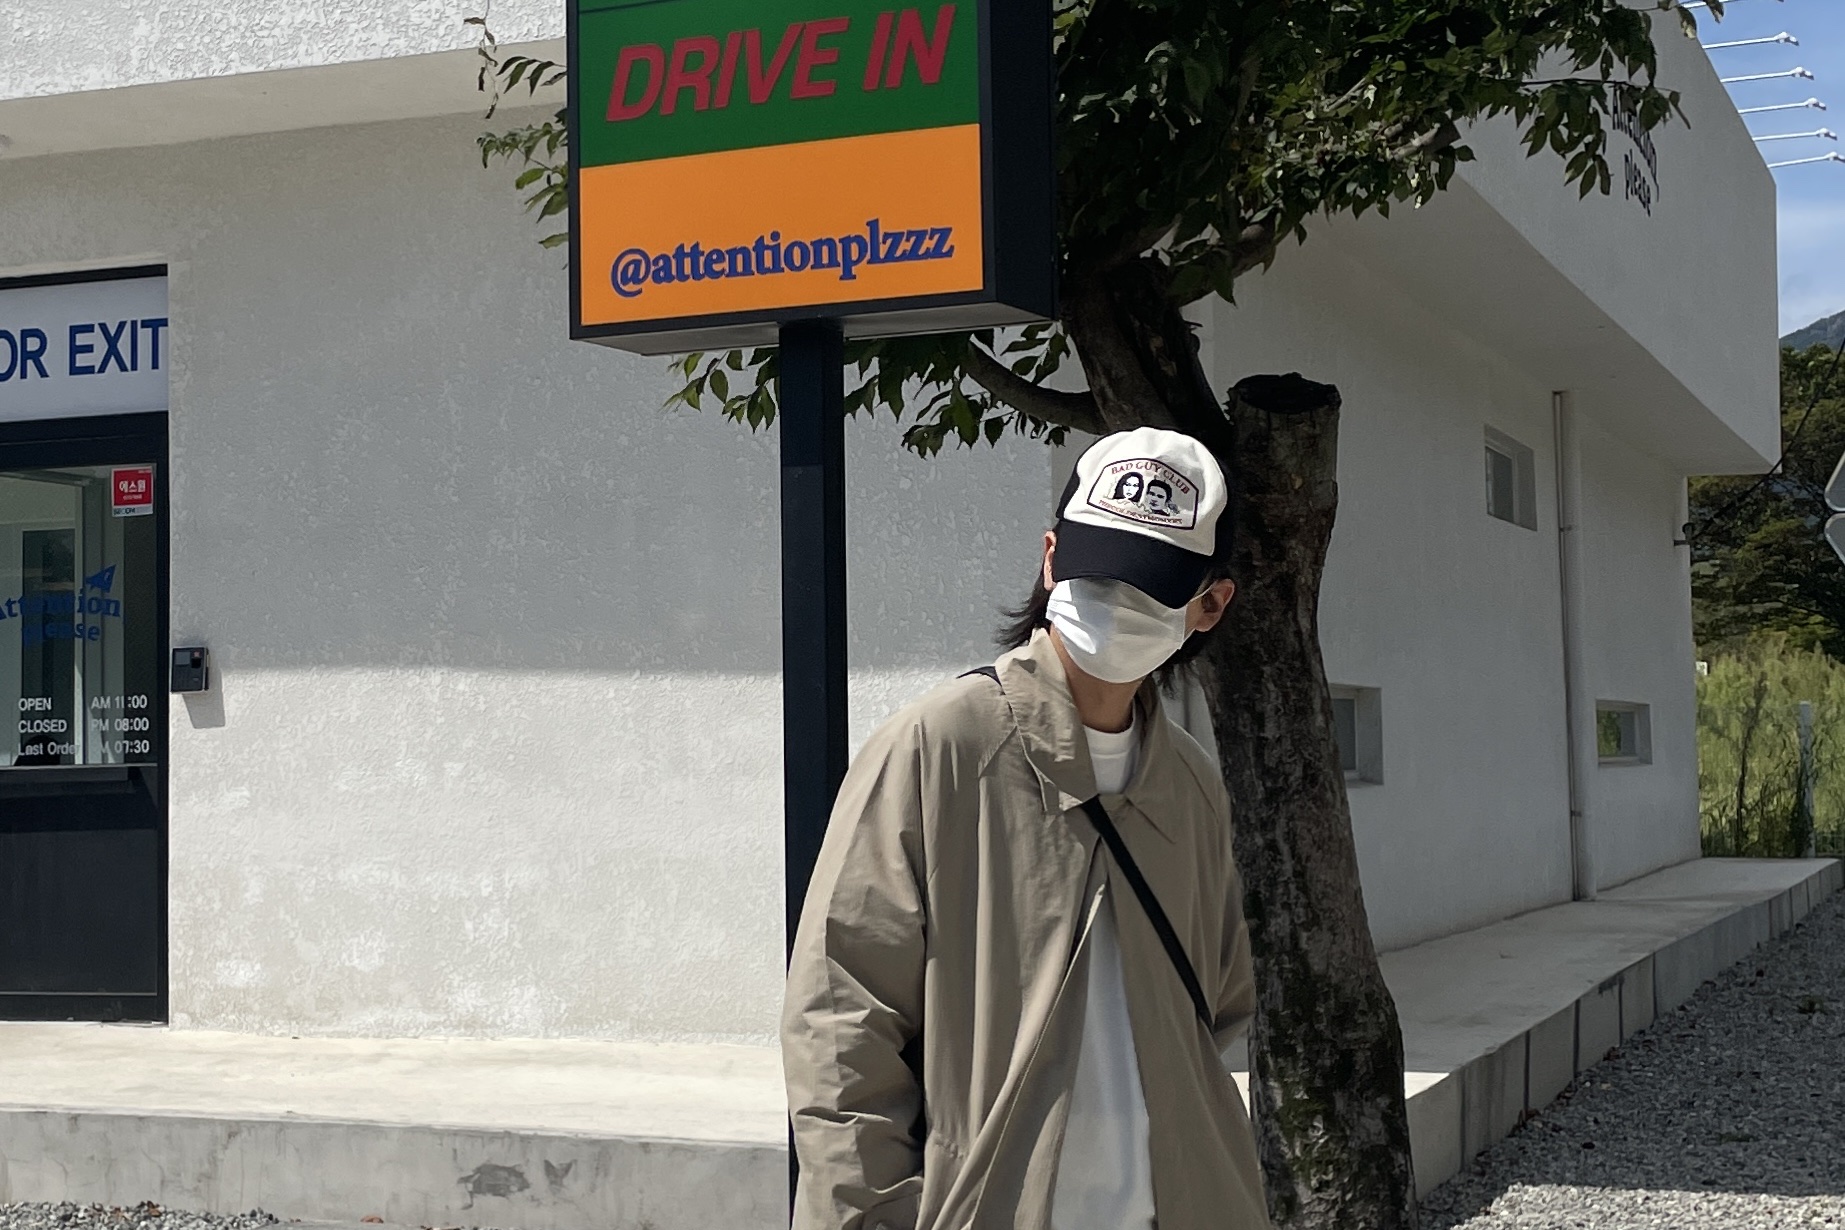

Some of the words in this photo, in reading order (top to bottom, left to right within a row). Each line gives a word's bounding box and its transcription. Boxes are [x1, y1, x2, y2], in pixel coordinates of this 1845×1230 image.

[606, 16, 850, 122] DRIVE
[863, 4, 956, 92] IN
[610, 218, 955, 298] @attentionplzzz
[69, 318, 168, 376] EXIT
[1111, 463, 1134, 475] BAD
[1135, 461, 1162, 473] GUY
[1164, 469, 1190, 495] CLUB
[18, 697, 52, 711] OPEN
[91, 696, 111, 709] AM
[18, 719, 67, 733] CLOSED
[91, 718, 109, 731] PM
[114, 717, 149, 731] 08:00
[18, 742, 43, 755] Last
[114, 740, 150, 753] 07:30
